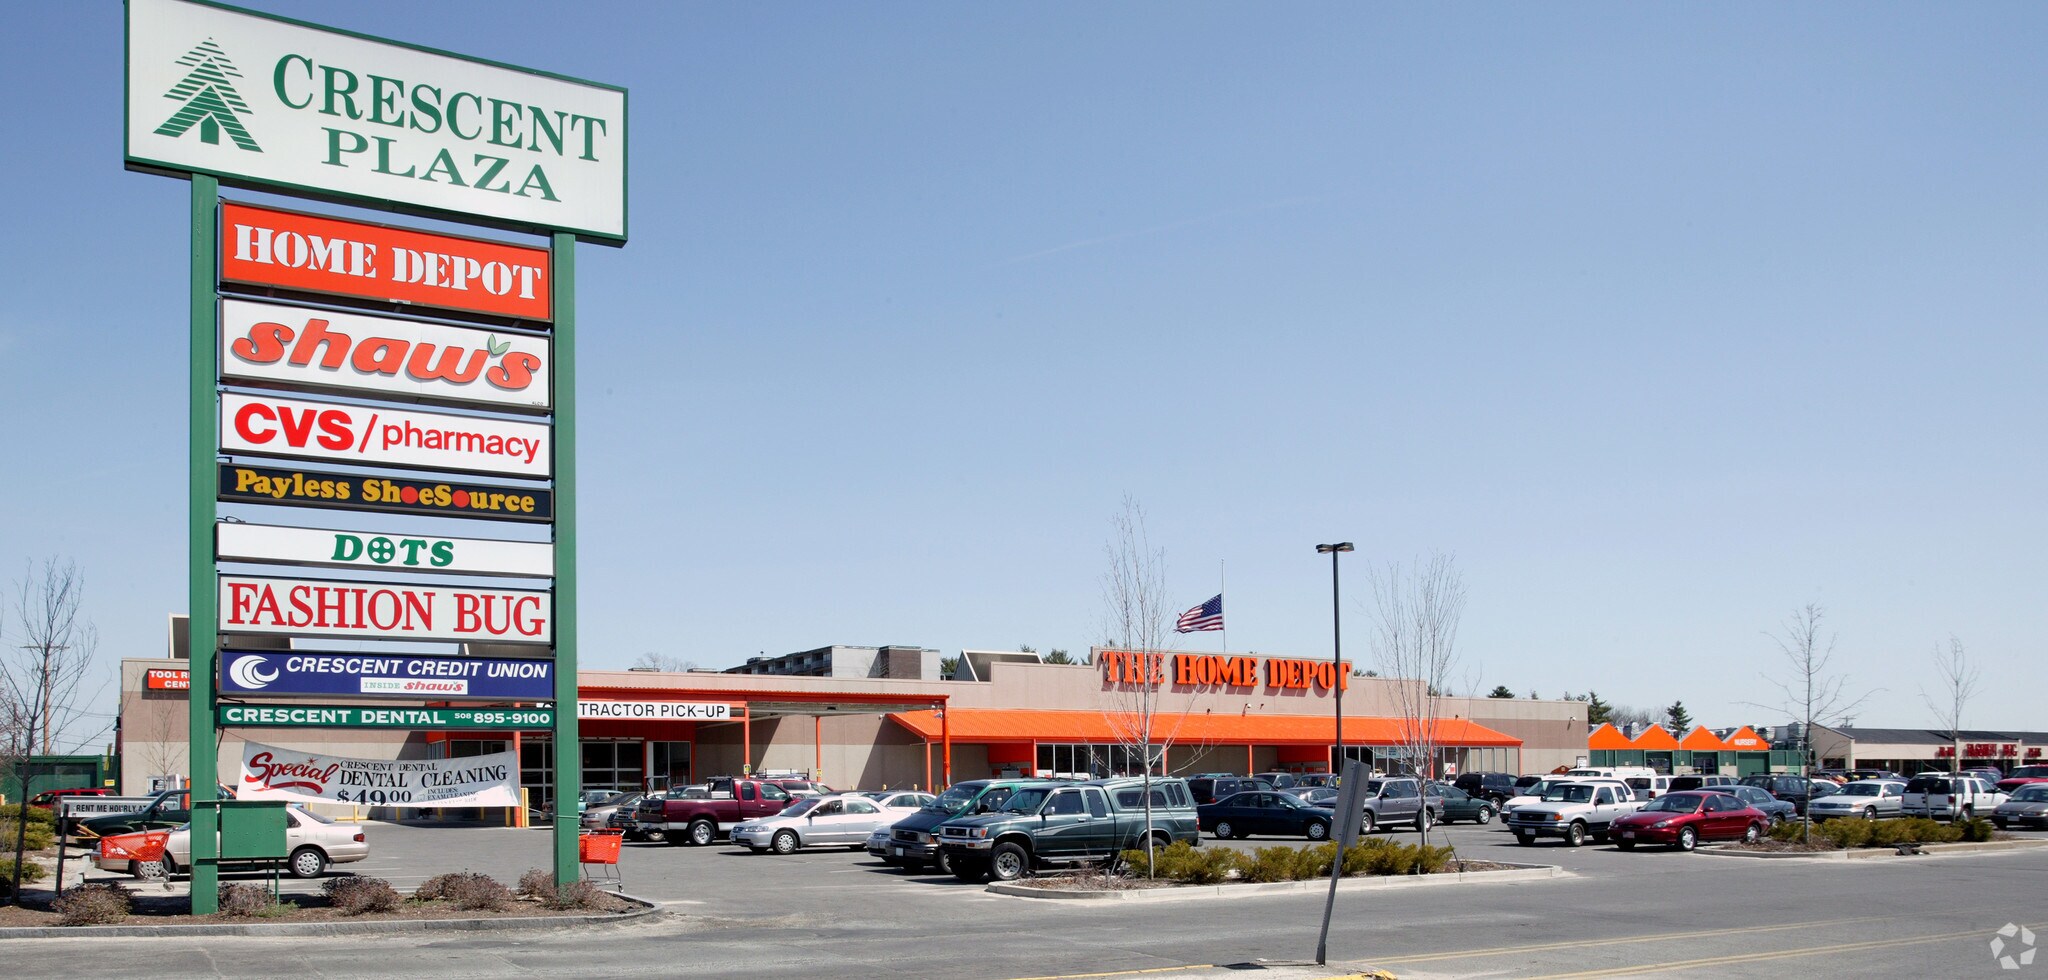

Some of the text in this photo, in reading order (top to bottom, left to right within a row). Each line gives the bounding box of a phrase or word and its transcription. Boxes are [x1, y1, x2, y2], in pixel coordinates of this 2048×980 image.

[273, 54, 607, 162] CRESCENT
[321, 127, 562, 202] PLAZA
[234, 224, 542, 300] HOME DEPOT
[235, 469, 350, 499] Payless
[331, 534, 454, 567] DOTS
[227, 583, 546, 636] FASHION BUG
[149, 670, 179, 679] TOOL
[286, 657, 548, 678] CRESCENT CREDIT UNION
[1101, 650, 1351, 692] THE HOME DEPOT
[164, 680, 190, 688] CEN
[226, 708, 352, 724] CRESCENT
[361, 710, 447, 724] DENTAL
[473, 712, 550, 724] 895-9100
[579, 703, 725, 718] TRACTOR PICK-UP
[245, 752, 339, 789] Special
[339, 765, 507, 788] DENTAL CLEANING
[340, 760, 437, 771] CRESCENT DENTAL
